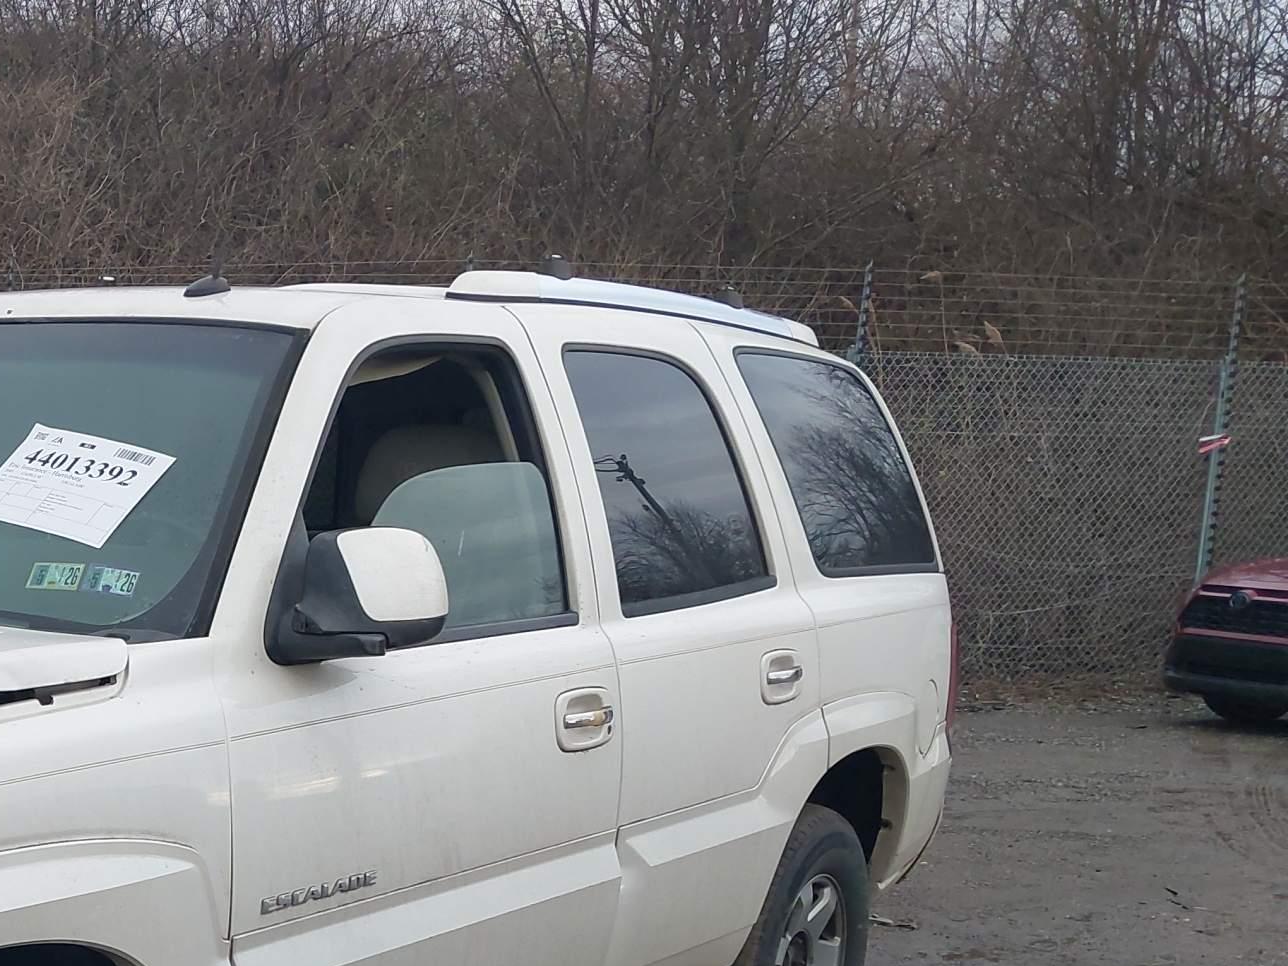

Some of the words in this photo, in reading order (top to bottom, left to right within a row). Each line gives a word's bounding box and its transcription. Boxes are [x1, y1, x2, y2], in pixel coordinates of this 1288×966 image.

[24, 448, 138, 486] 44013392
[90, 572, 100, 589] 5
[260, 869, 377, 915] ESCALADE
